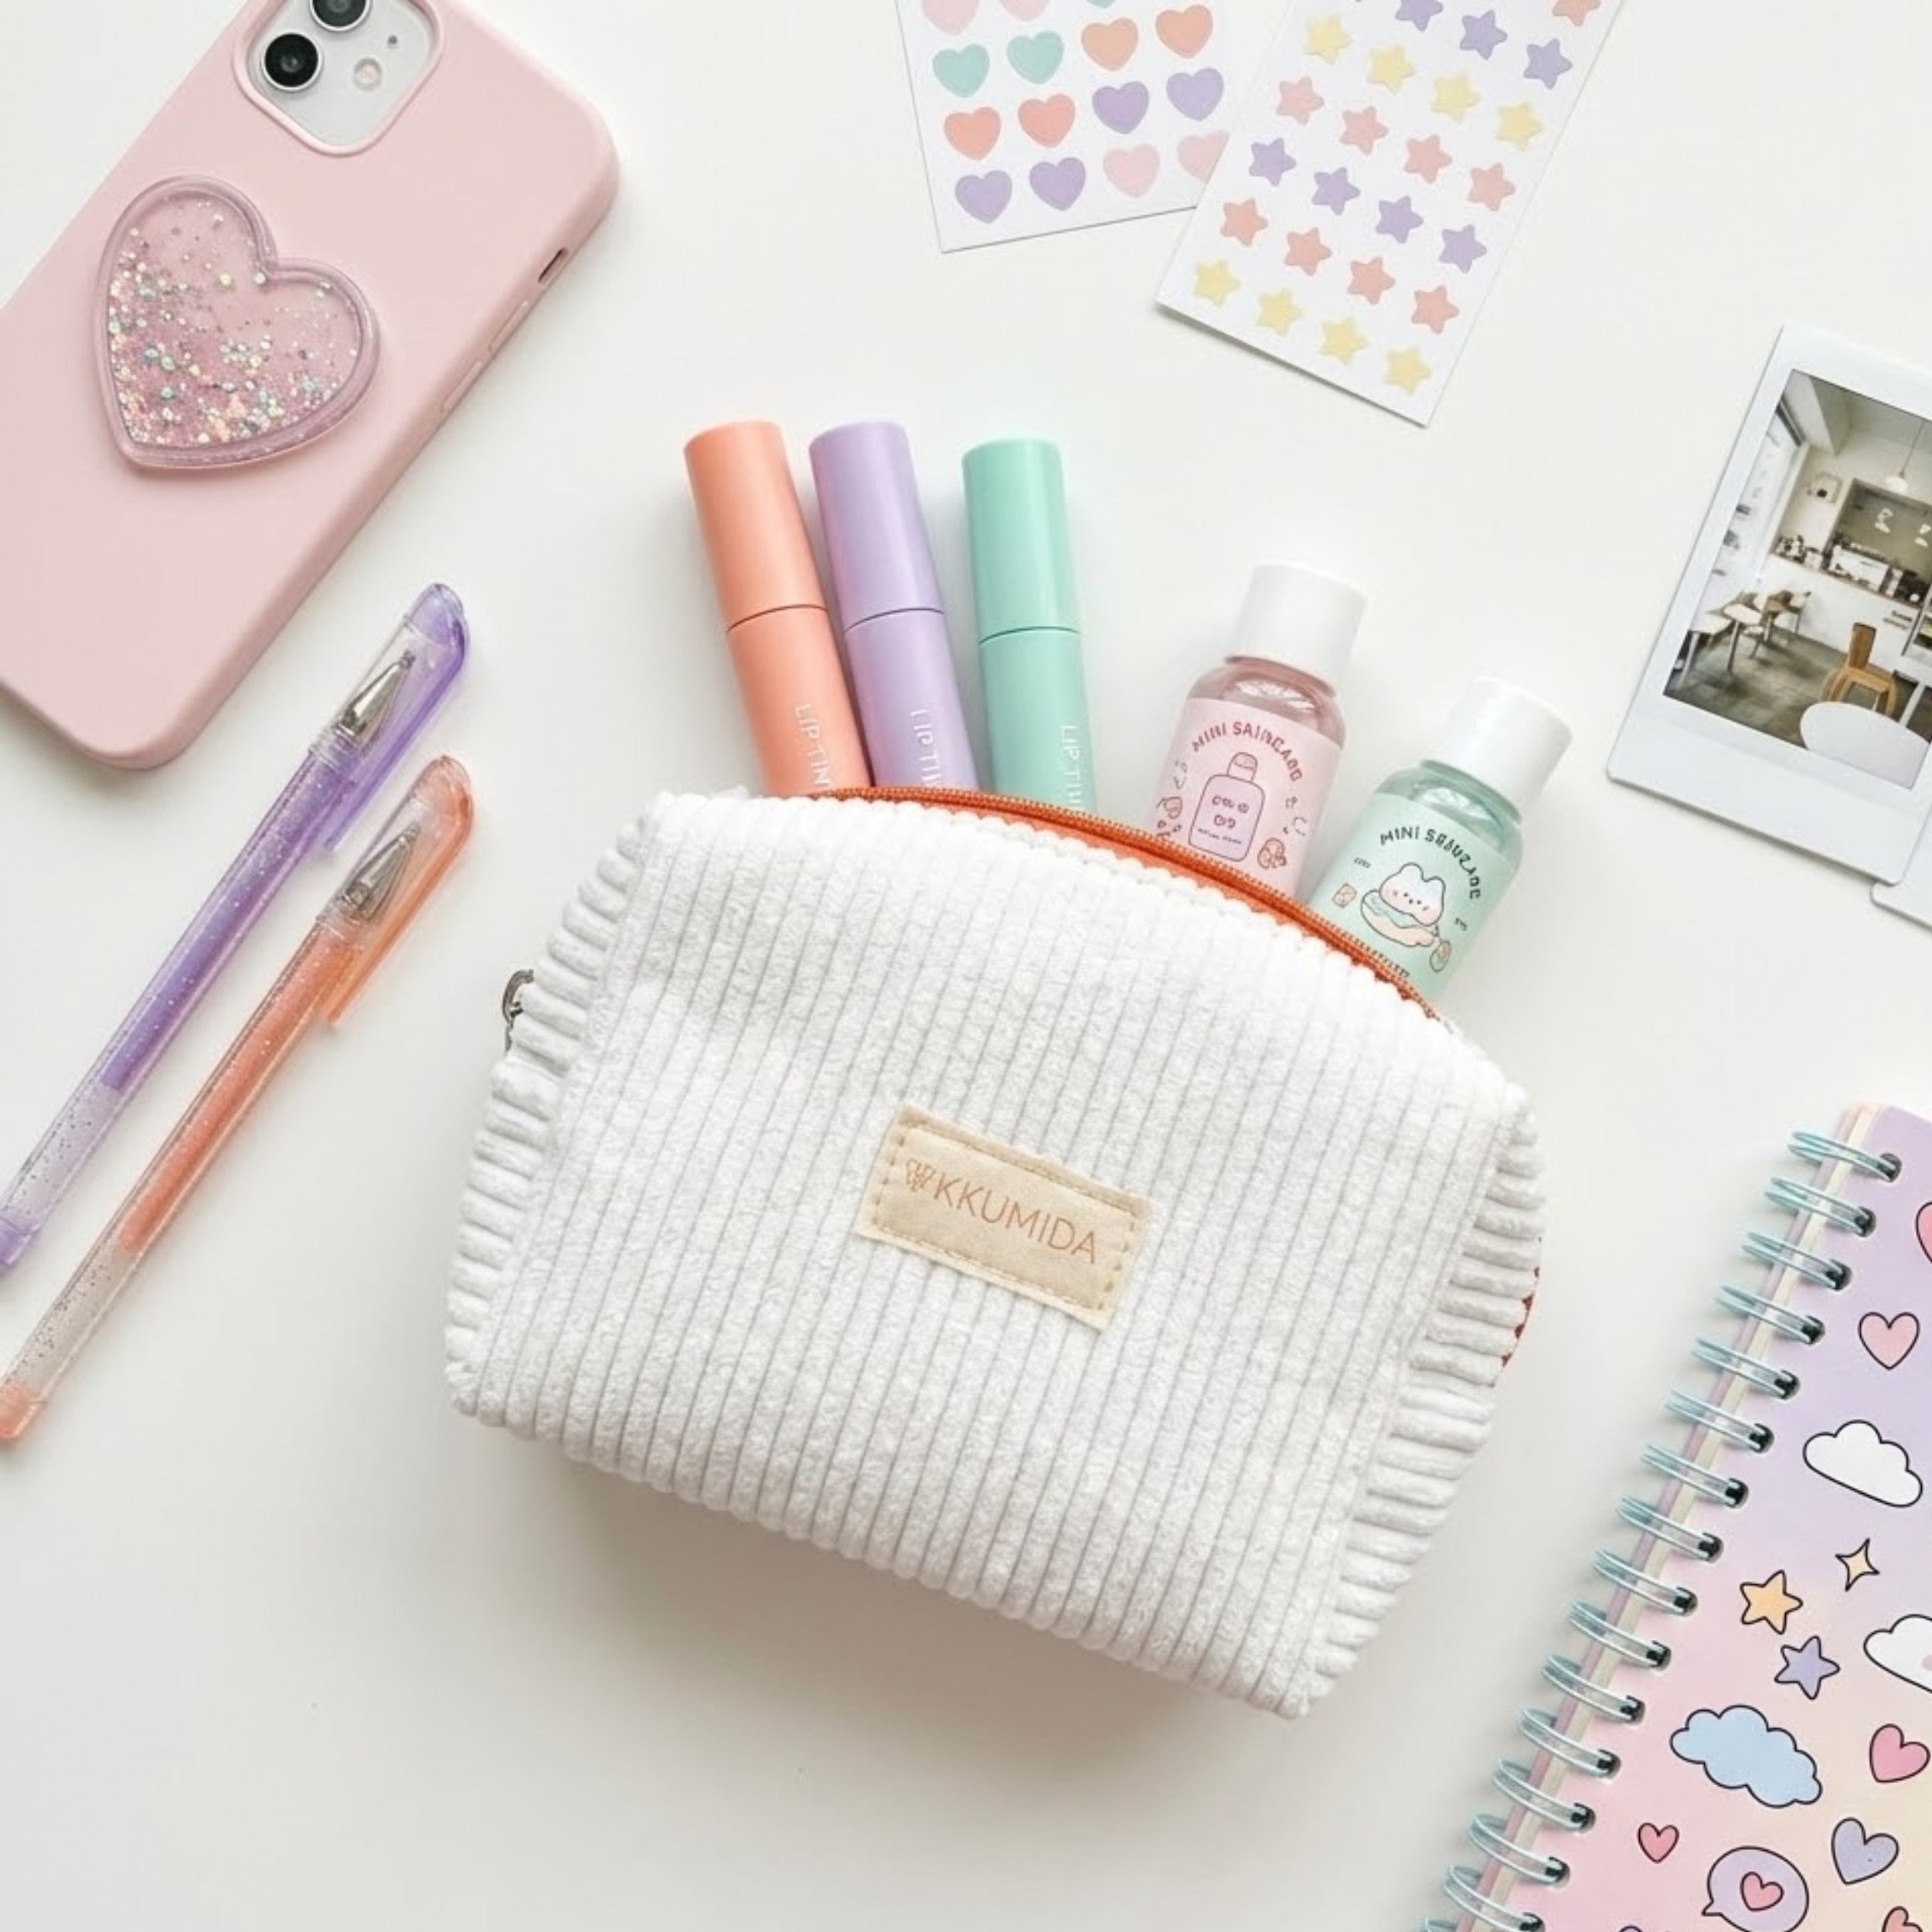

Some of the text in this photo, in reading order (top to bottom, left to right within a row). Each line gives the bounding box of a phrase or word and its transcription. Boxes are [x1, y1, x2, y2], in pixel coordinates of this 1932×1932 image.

[794, 702, 821, 740] LIP
[910, 709, 934, 745] LIP
[1060, 725, 1080, 760] LIP
[1379, 826, 1421, 846] MINI
[933, 1172, 1097, 1265] KKUMIDA
